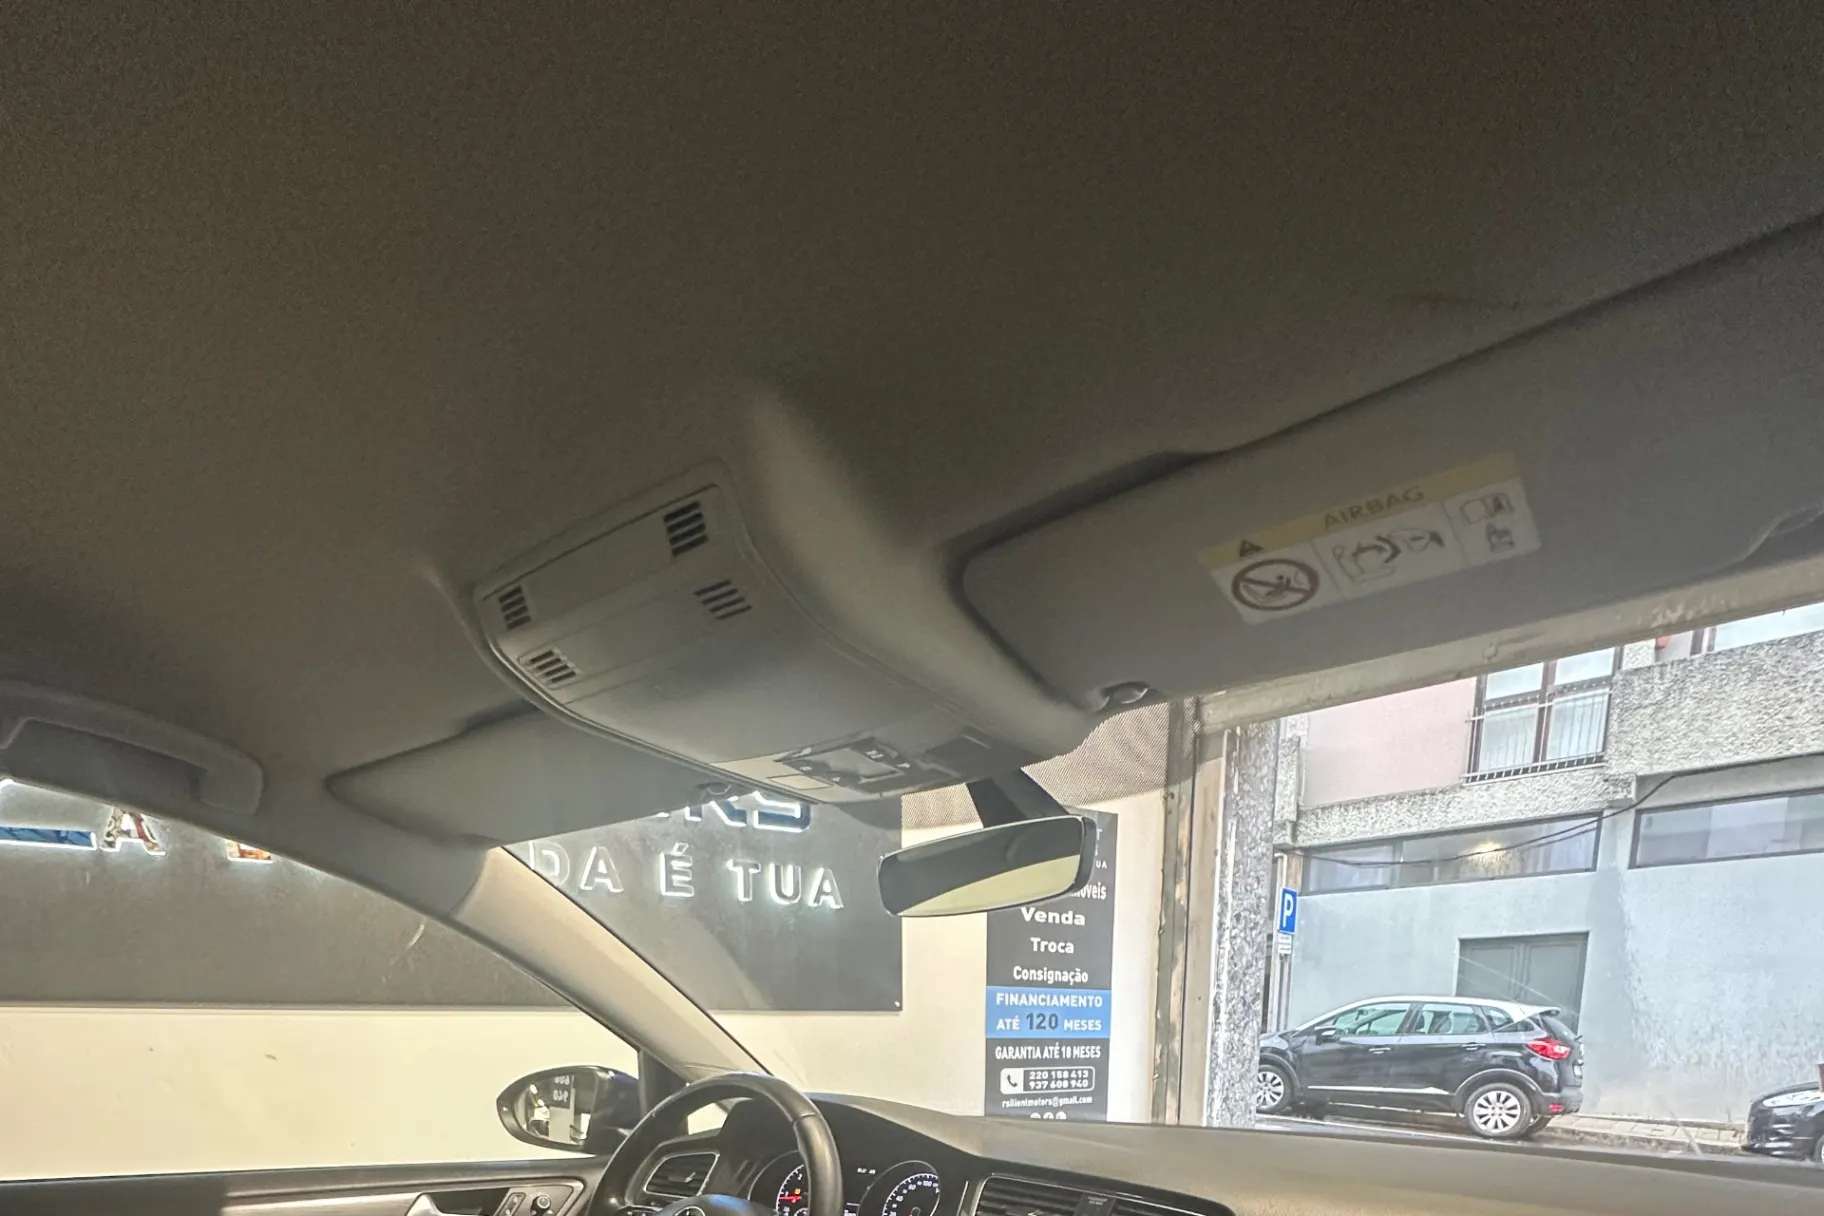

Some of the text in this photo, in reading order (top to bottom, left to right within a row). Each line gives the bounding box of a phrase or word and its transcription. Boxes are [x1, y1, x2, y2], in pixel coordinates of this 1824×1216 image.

[1324, 485, 1425, 529] AIRBAG
[659, 841, 695, 898] É
[726, 858, 844, 910] TUA
[1020, 906, 1086, 926] Venda
[1282, 892, 1294, 928] P
[1030, 937, 1074, 954] Troca
[1013, 965, 1089, 986] Consignação
[996, 992, 1103, 1008] FINANCIAMENTO
[996, 1012, 1102, 1031] ATÉ 120 MESES
[995, 1045, 1041, 1060] GARANTIA
[1042, 1042, 1060, 1060] ATÉ
[1072, 1045, 1101, 1059] MESES
[1029, 1070, 1049, 1080] 220
[1028, 1080, 1048, 1090] 937
